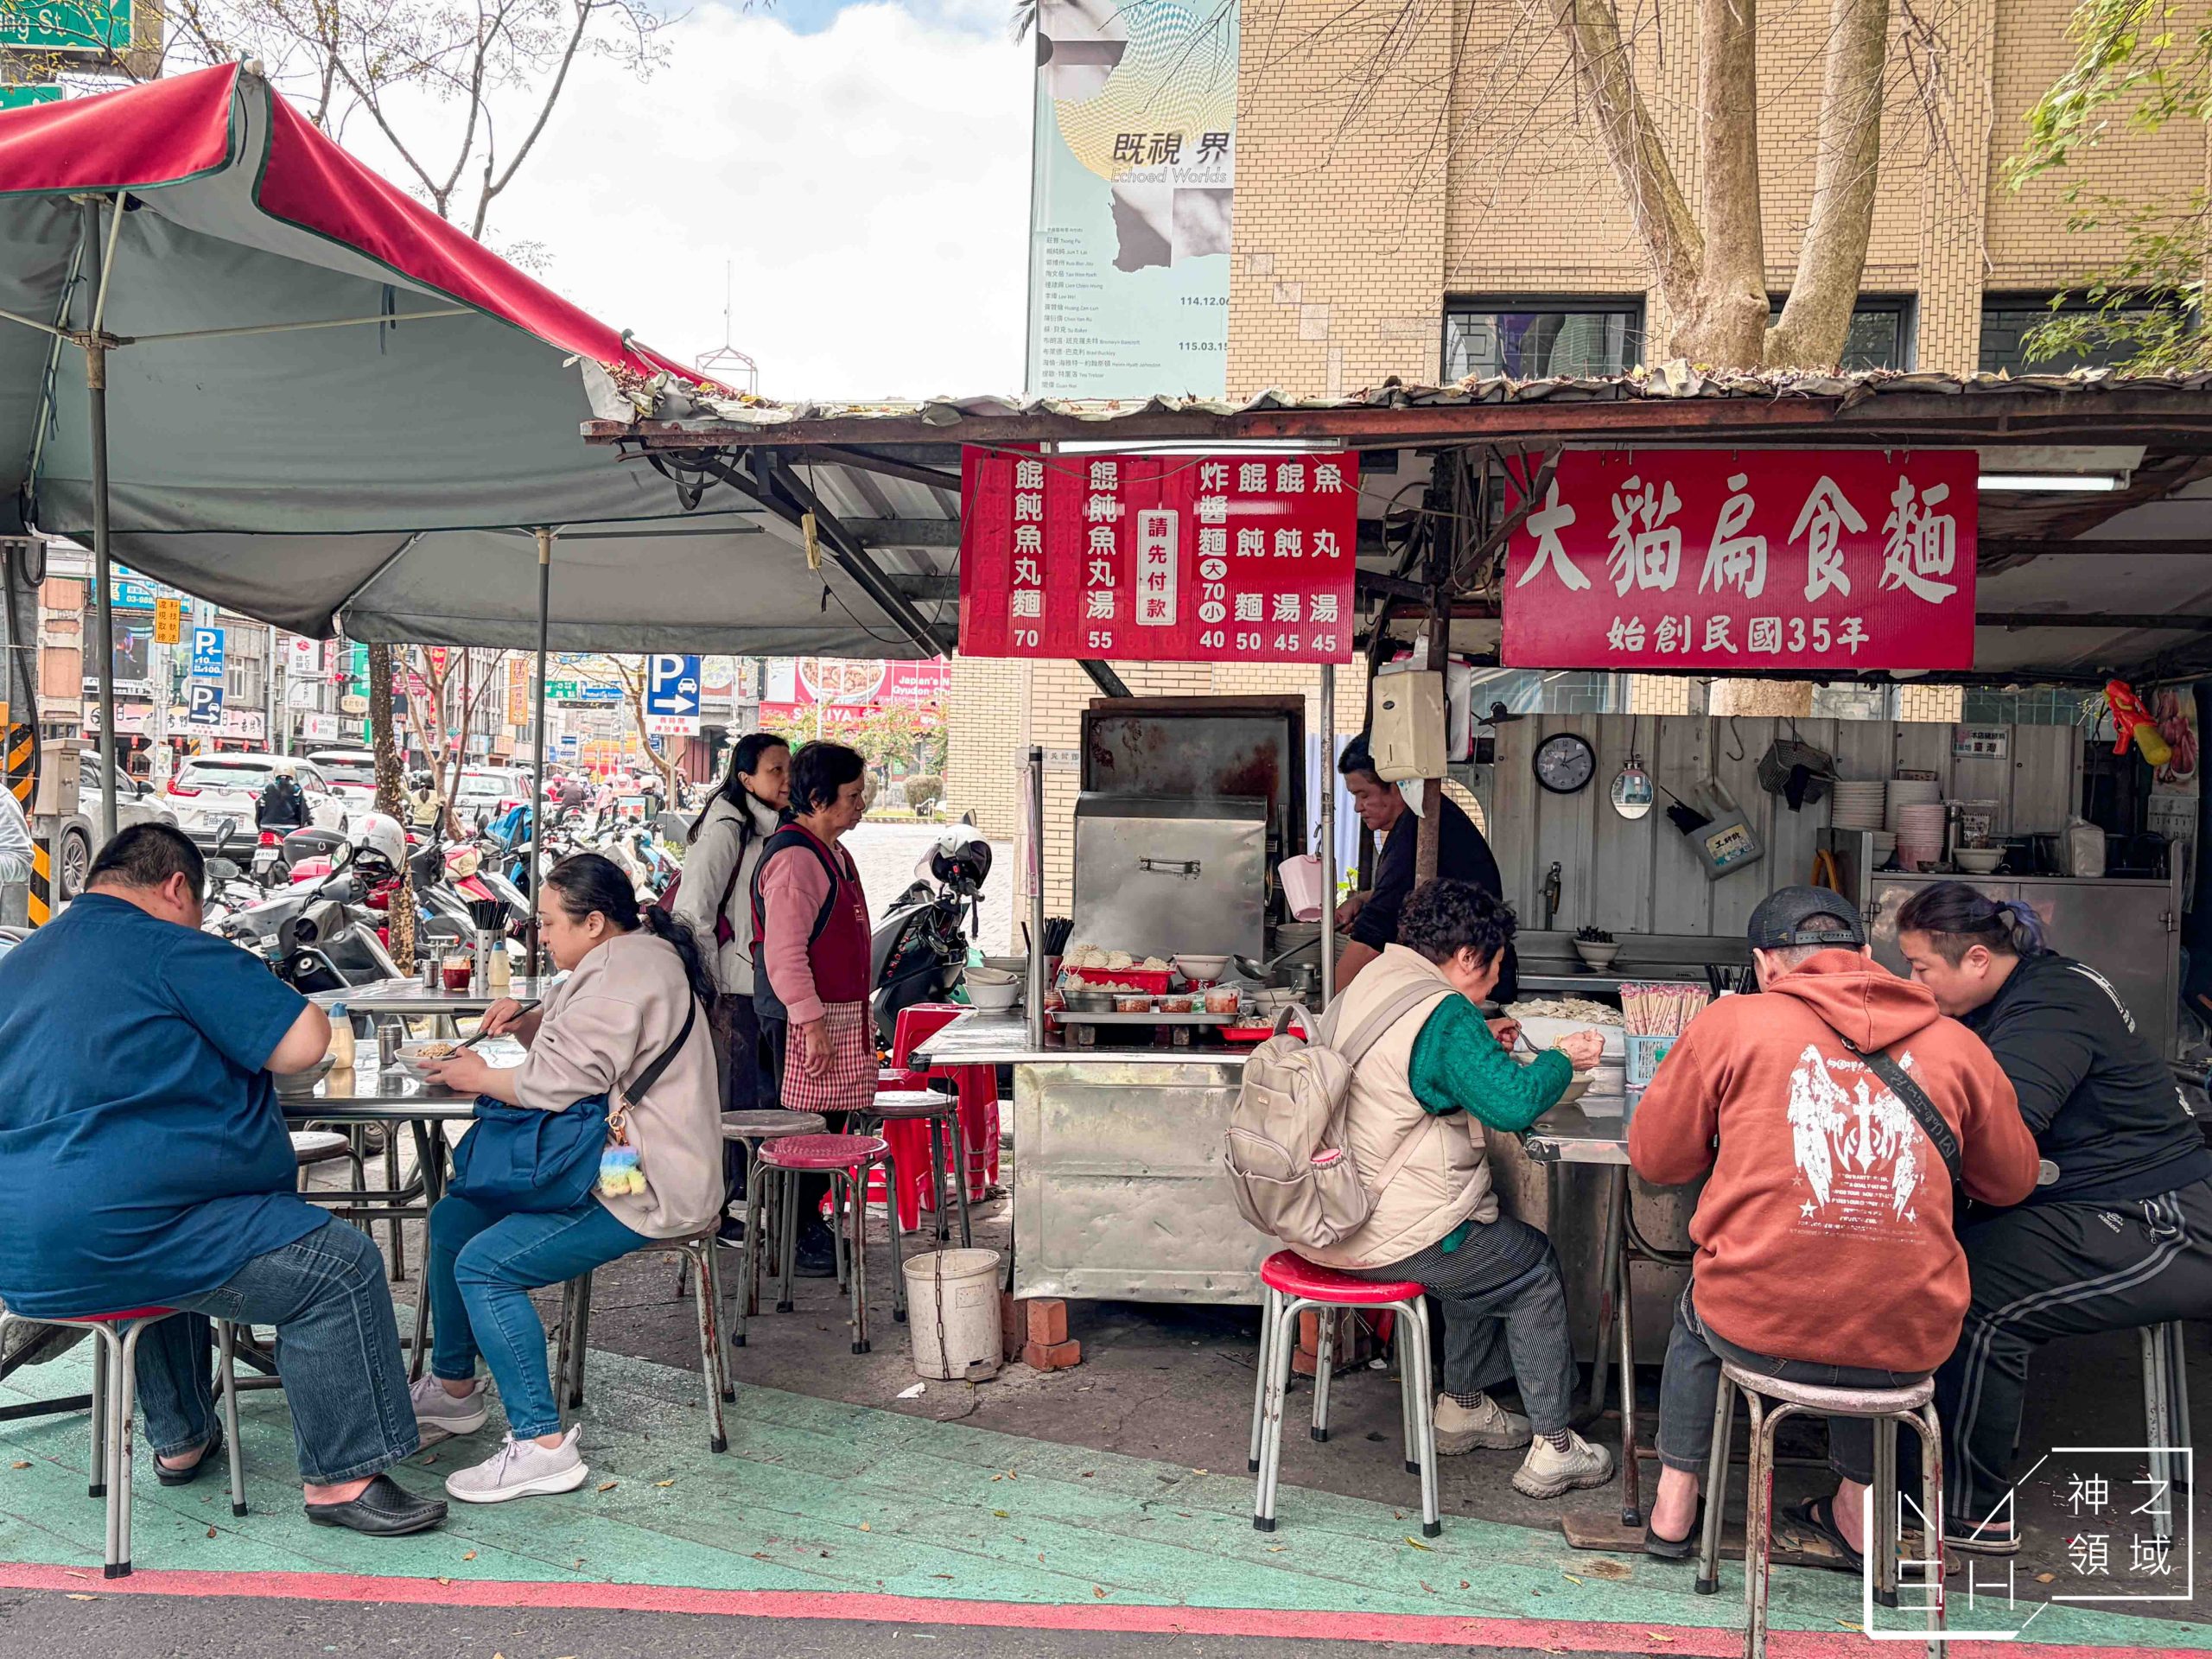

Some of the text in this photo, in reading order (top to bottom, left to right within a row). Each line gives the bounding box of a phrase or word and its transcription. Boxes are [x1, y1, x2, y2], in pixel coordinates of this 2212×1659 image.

[1111, 167, 1226, 183] Echoed Worlds
[1198, 462, 1230, 557] 炸醬麵
[1013, 460, 1044, 618] 餛飩魚丸麵
[1086, 461, 1118, 620] 餛飩魚丸湯
[1515, 473, 1958, 604] 大貓扁食麵
[1147, 517, 1167, 619] 請先付款
[1202, 582, 1225, 601] 70
[195, 631, 216, 655] P
[1014, 630, 1039, 647] 70
[1088, 631, 1112, 648] 55
[1199, 631, 1225, 648] 40
[1236, 632, 1261, 650] 50
[1274, 634, 1299, 652] 45
[1312, 635, 1337, 652] 45
[1606, 614, 1871, 655] 始創民國35年
[652, 655, 684, 693] P
[899, 676, 939, 685] Japan's
[192, 687, 213, 710] P
[893, 685, 930, 695] Gyudon
